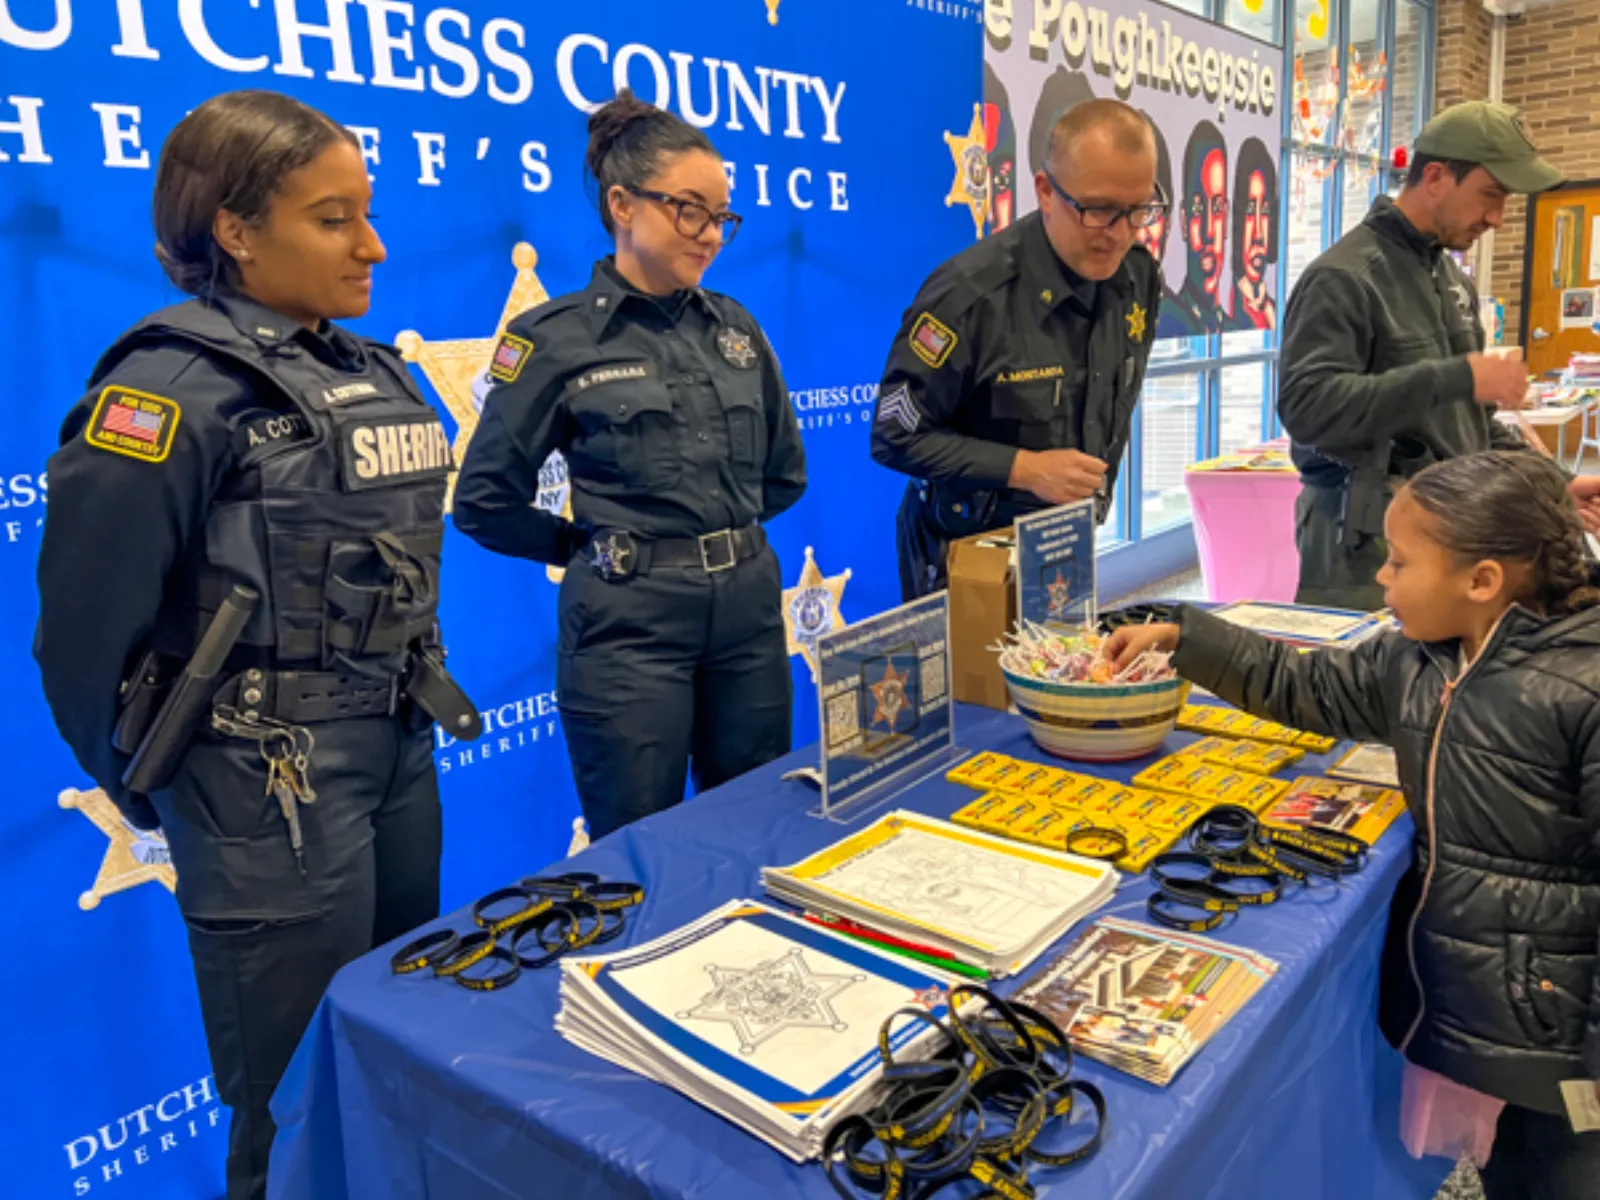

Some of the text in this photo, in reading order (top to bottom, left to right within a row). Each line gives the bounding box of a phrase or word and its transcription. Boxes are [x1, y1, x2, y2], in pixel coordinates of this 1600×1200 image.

[556, 33, 846, 144] COUNTY
[1028, 0, 1276, 113] Poughkeepsie
[63, 1073, 220, 1170] DUTCH
